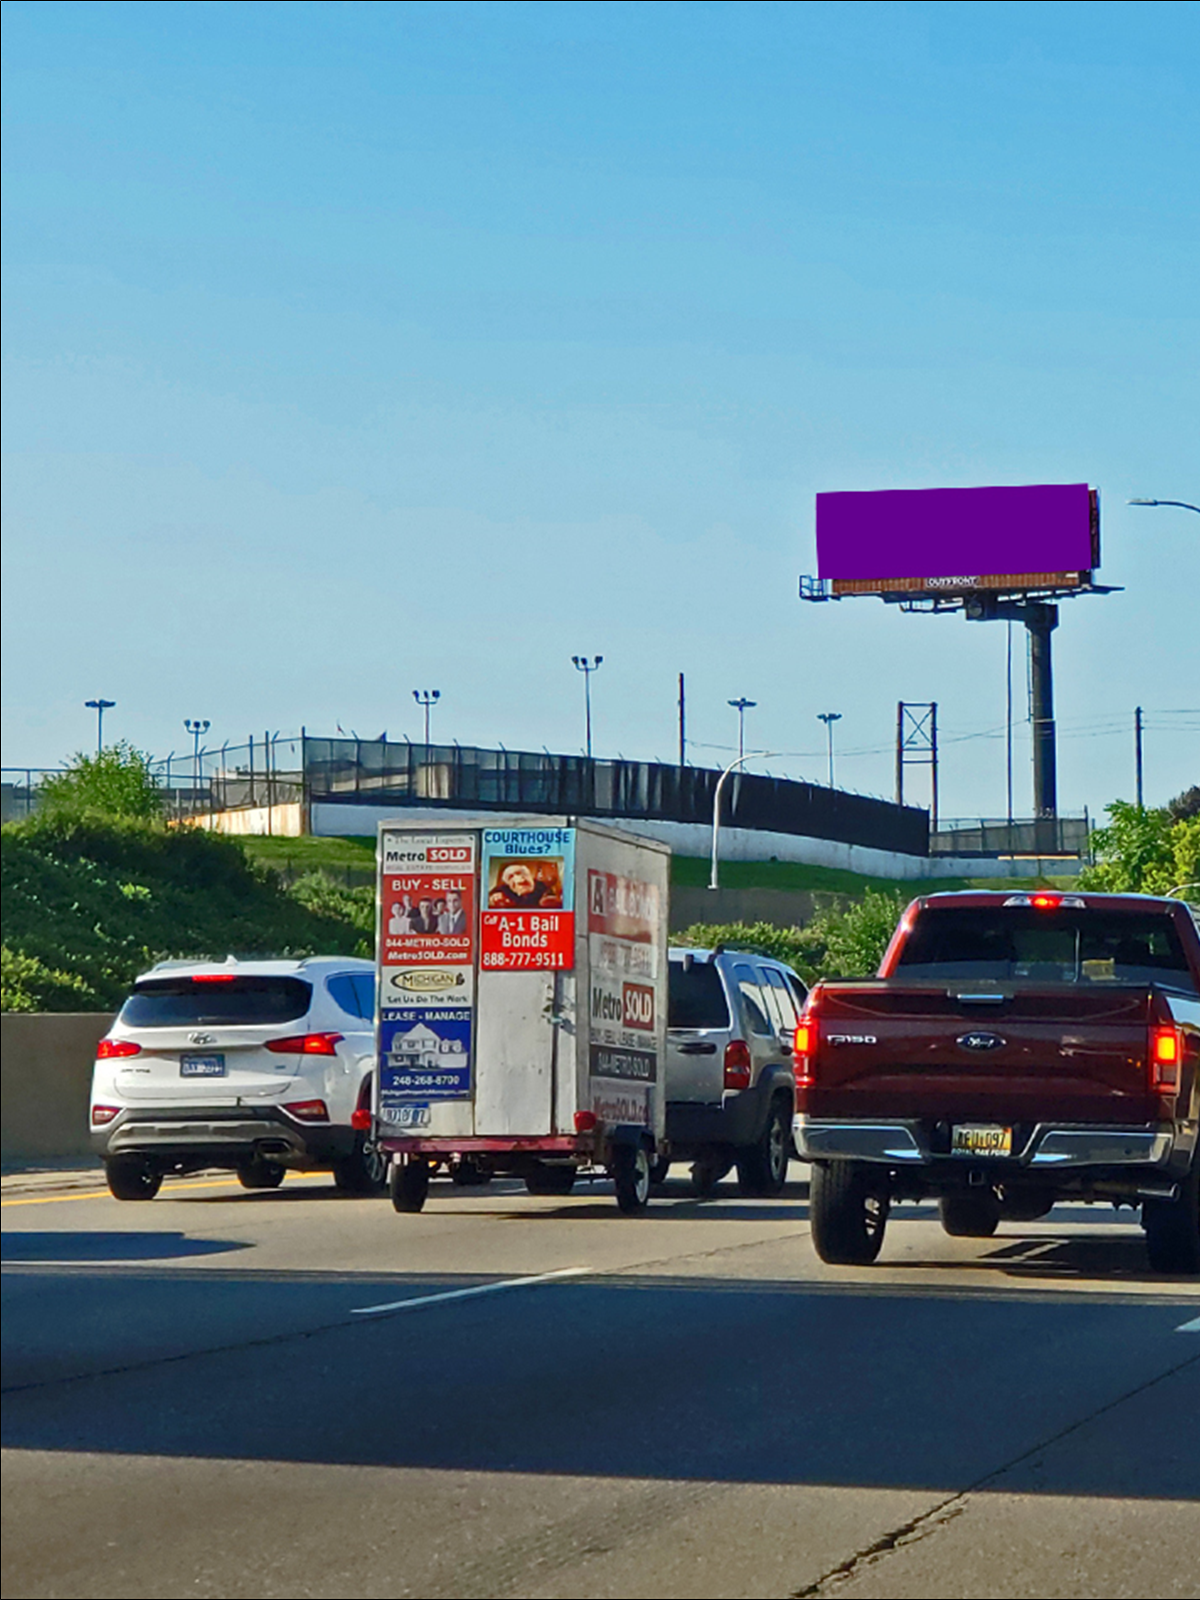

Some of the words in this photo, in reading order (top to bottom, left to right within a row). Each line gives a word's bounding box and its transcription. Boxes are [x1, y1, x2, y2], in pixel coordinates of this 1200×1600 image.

[484, 832, 570, 843] COURTHOUSE
[505, 844, 551, 854] Blues?
[386, 851, 426, 862] Metro
[430, 849, 467, 860] SOLD
[392, 879, 421, 891] BUY
[432, 879, 467, 891] SELL
[498, 916, 525, 931] A-1
[531, 916, 559, 931] Bail
[502, 931, 548, 947] Bonds
[483, 952, 564, 966] 888-777-9511
[430, 995, 444, 1003] The
[592, 987, 622, 1021] Metro
[625, 990, 652, 1023] SOLD
[383, 1011, 416, 1021] LEASE
[425, 1011, 471, 1020] MANAGE
